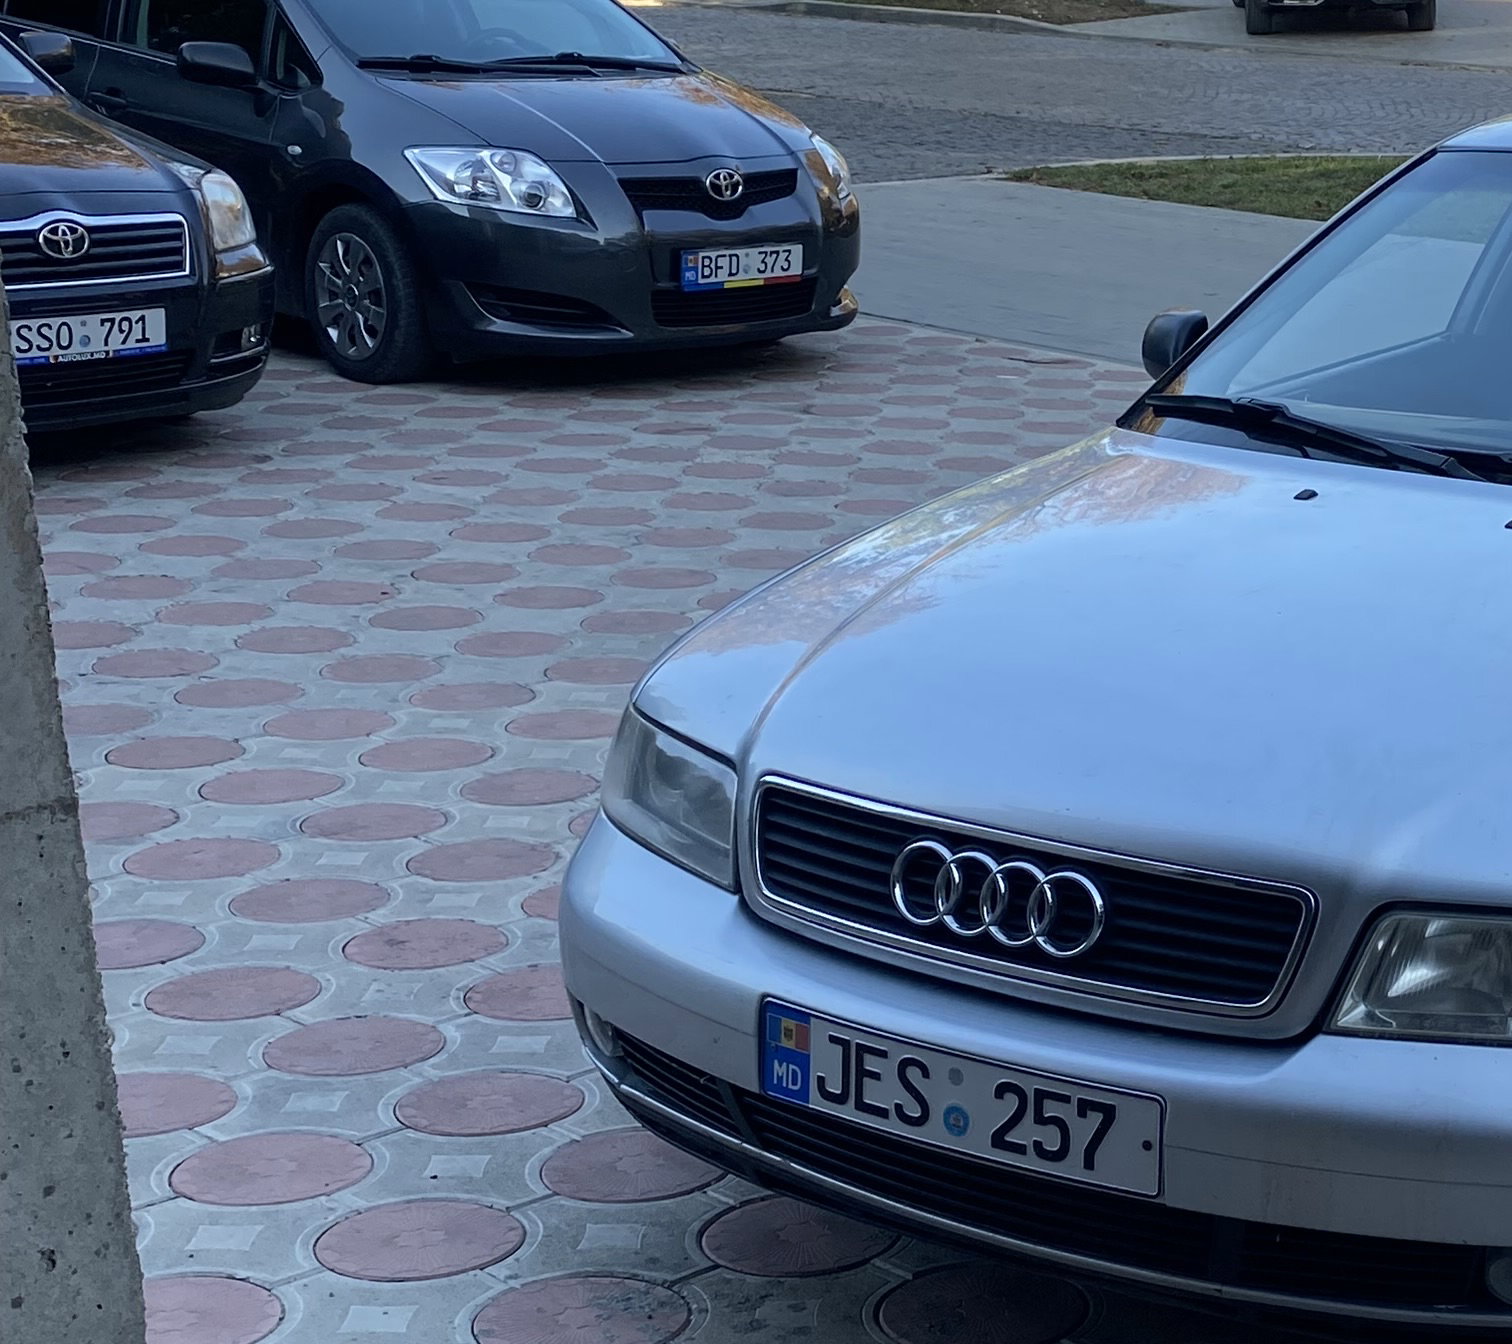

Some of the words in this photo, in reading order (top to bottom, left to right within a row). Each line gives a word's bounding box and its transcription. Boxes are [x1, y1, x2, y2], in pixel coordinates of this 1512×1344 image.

[701, 253, 740, 279] BFD
[757, 249, 792, 274] 373
[15, 321, 73, 354] SSO
[100, 314, 150, 347] 791
[772, 1058, 803, 1092] MD
[816, 1031, 932, 1128] JES
[990, 1079, 1118, 1172] 257
